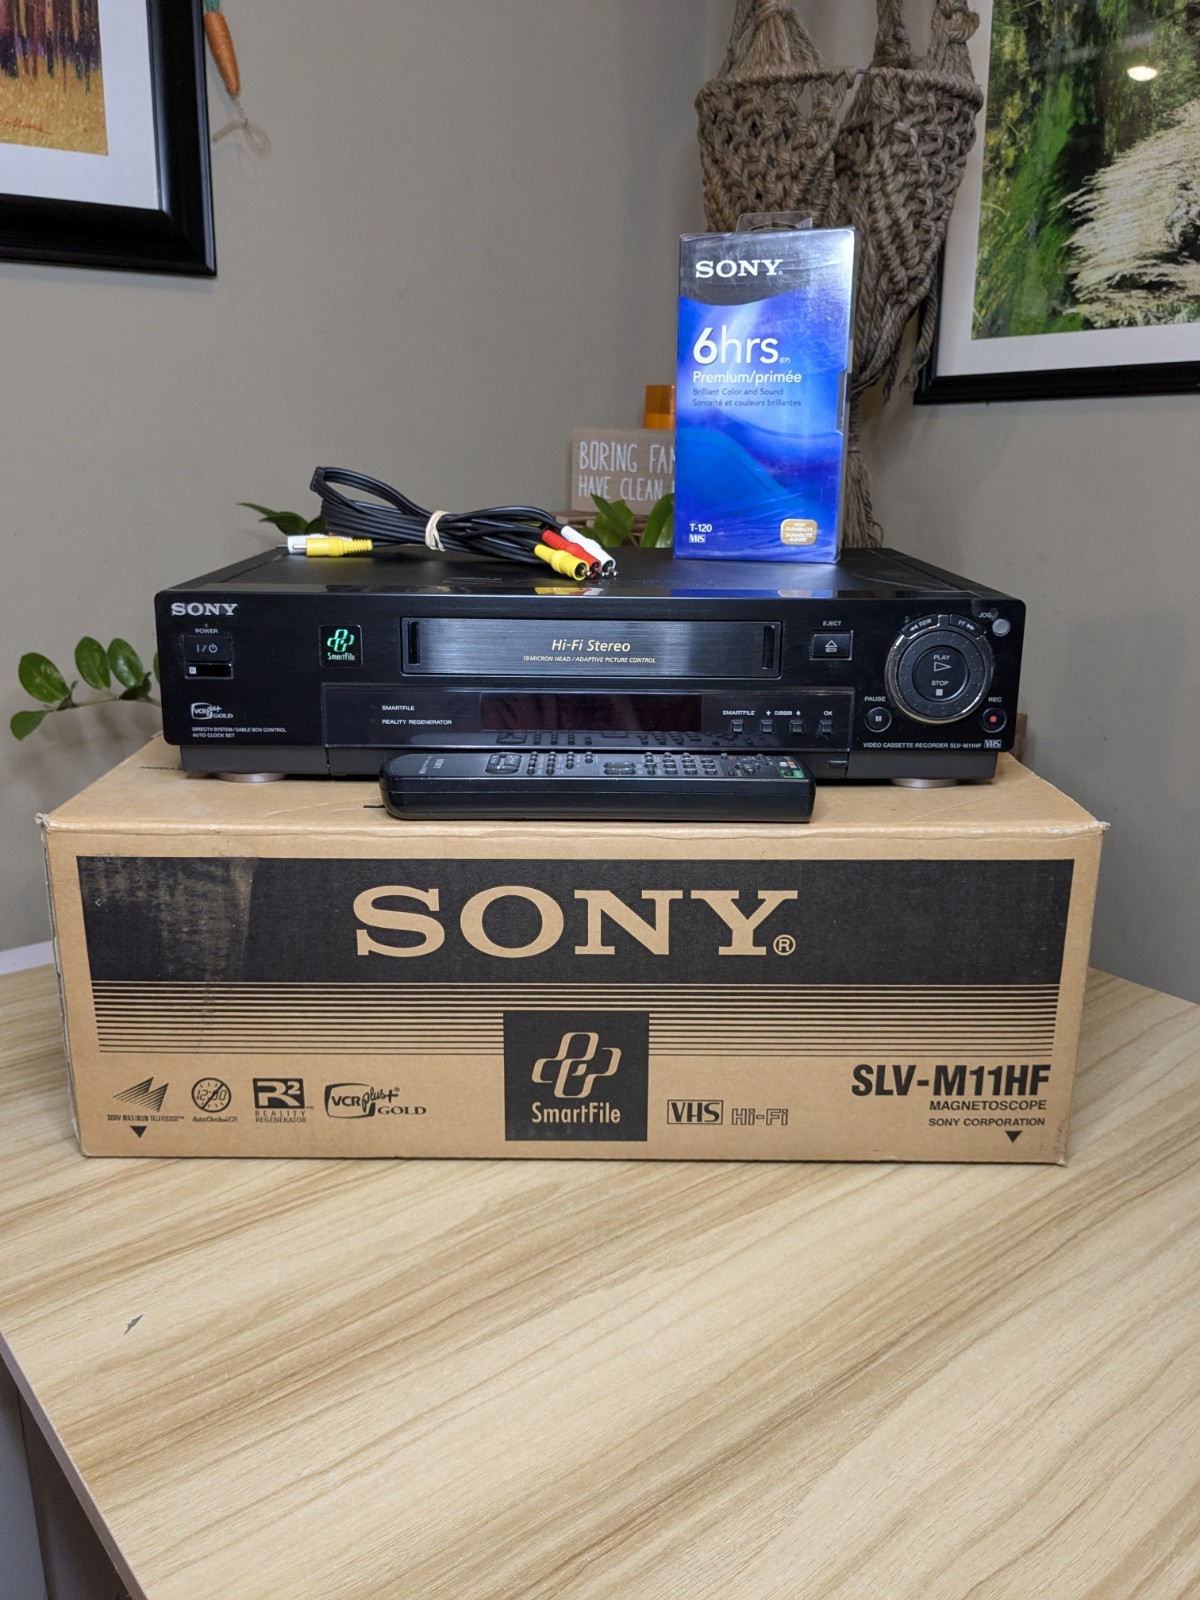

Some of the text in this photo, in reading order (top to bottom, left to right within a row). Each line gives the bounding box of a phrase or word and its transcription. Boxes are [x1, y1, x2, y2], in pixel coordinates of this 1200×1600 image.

[695, 259, 783, 278] SONY
[693, 325, 779, 365] 6hrs
[693, 370, 802, 387] Premium/primée
[692, 399, 722, 407] Sonorité
[734, 399, 766, 407] couleurs
[767, 399, 802, 407] brillantes
[579, 441, 638, 473] BORING
[578, 475, 612, 499] HAVE
[620, 477, 663, 501] CLEAN
[689, 523, 712, 532] T-120
[171, 602, 238, 616] SONY
[918, 618, 932, 626] REW
[552, 639, 631, 652] Hi-Fi Stereo
[328, 652, 356, 660] SmartFile
[984, 740, 1002, 748] VHS
[353, 885, 798, 958] SONY
[851, 1064, 1052, 1096] SLV-M11HF
[330, 1095, 360, 1107] VCR
[929, 1100, 1047, 1111] MAGNETOSCOPE
[377, 1106, 427, 1115] GOLD
[531, 1102, 621, 1124] SmartFile
[670, 1102, 789, 1126] VHS Hi-Fi
[928, 1118, 1046, 1126] SONY CORPORATION
